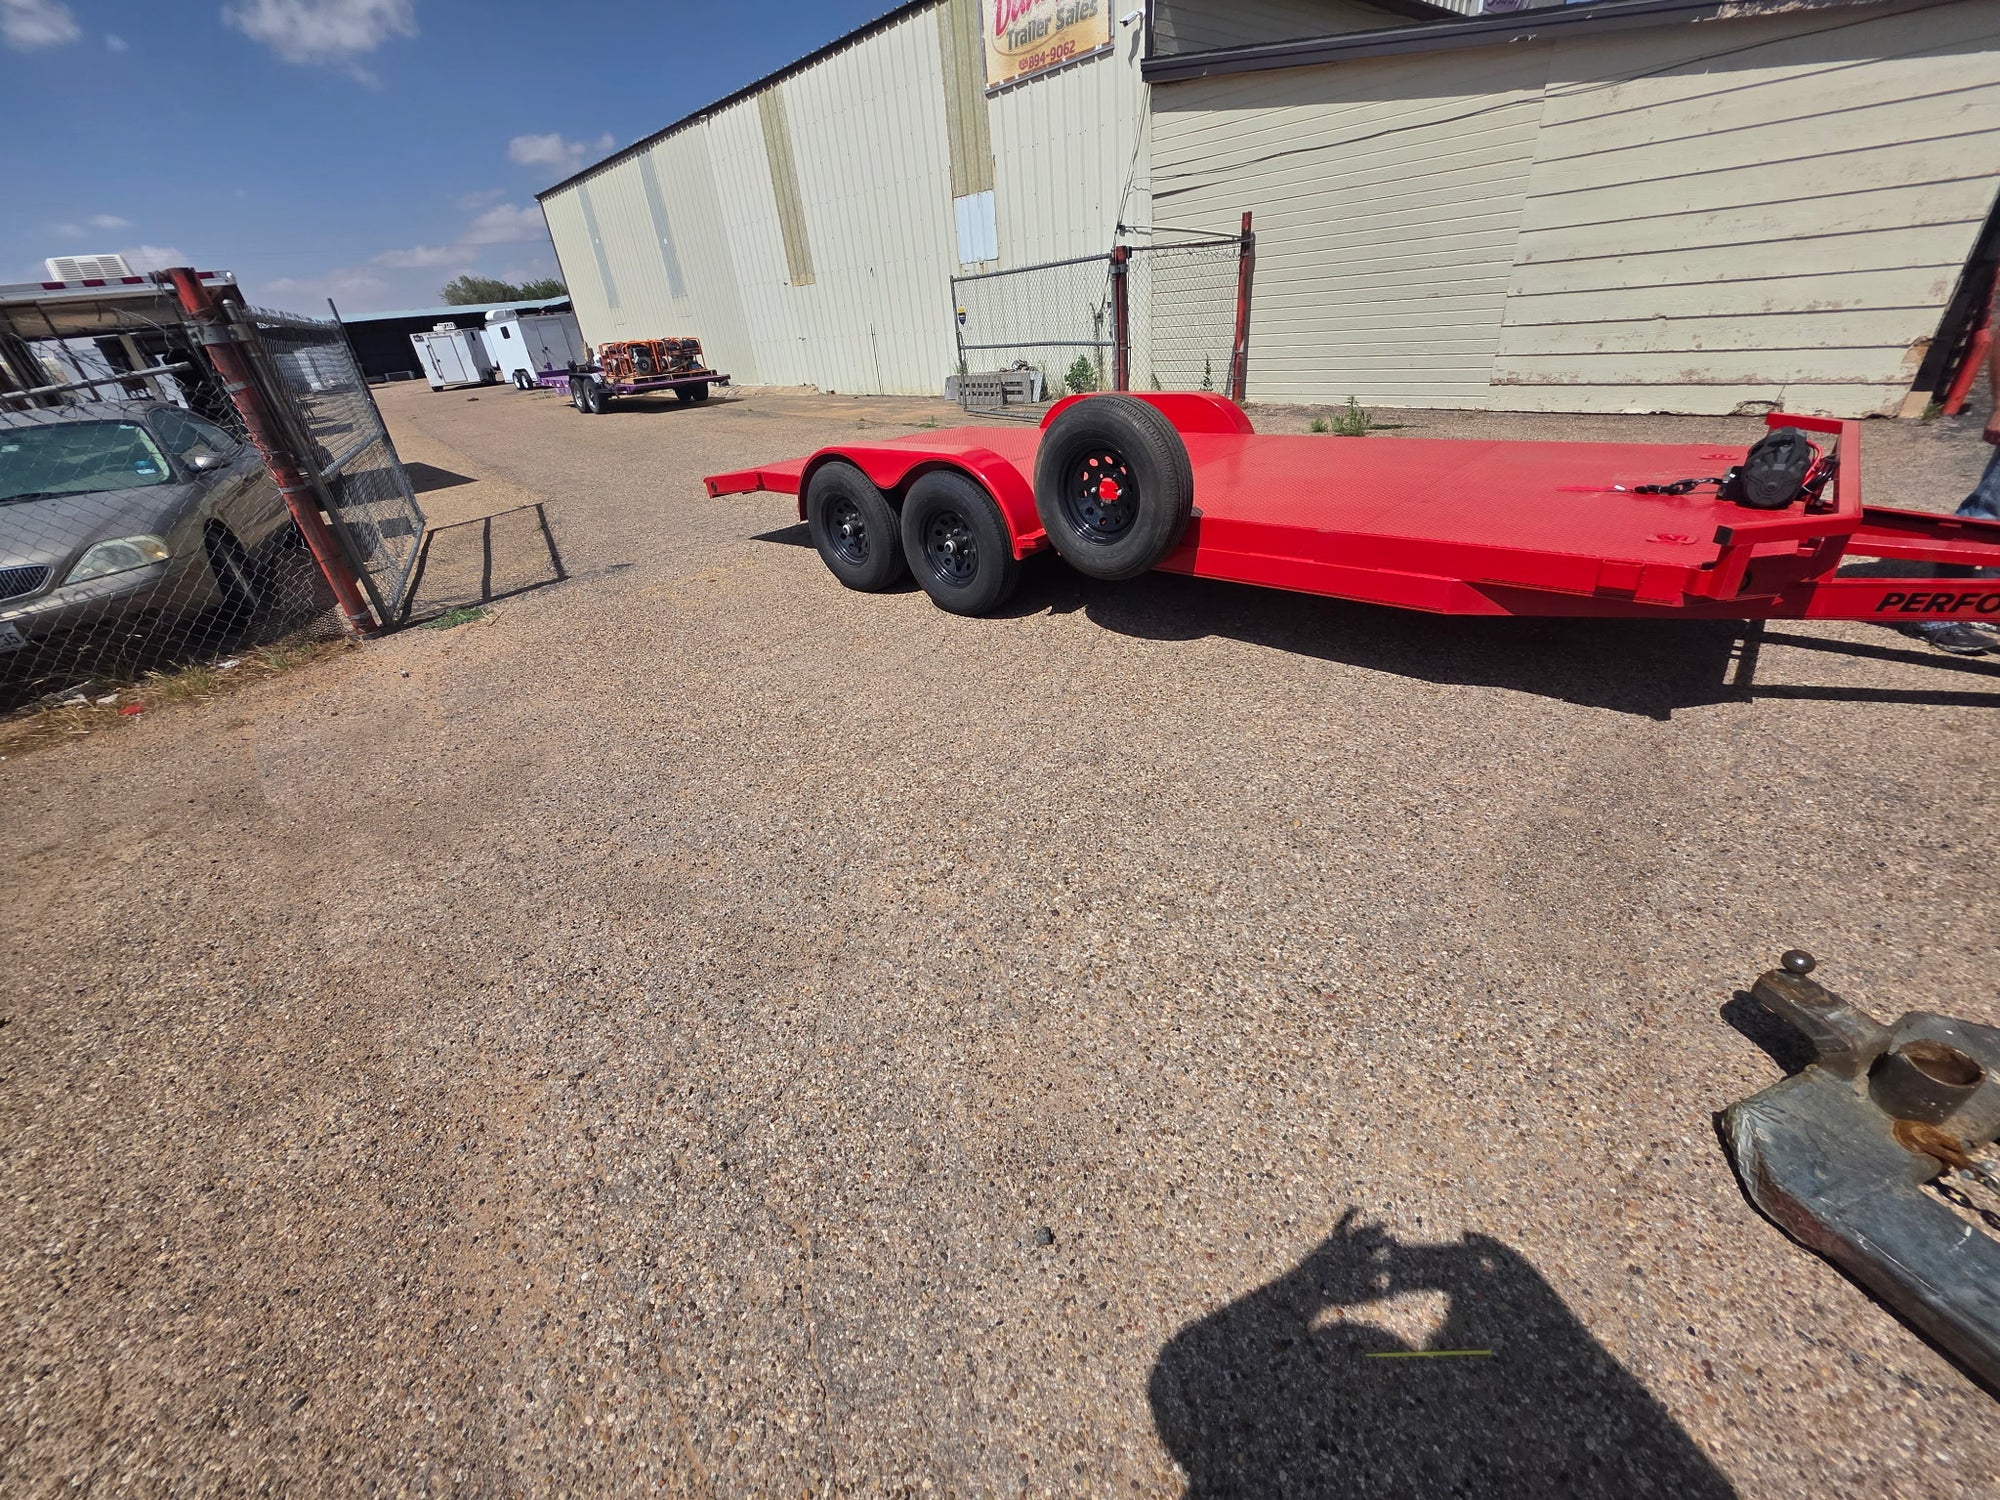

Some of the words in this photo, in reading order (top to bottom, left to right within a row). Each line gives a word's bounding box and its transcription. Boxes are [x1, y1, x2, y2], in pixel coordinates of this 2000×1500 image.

[1007, 16, 1051, 51] Trailer
[1055, 0, 1098, 30] Sales
[1029, 39, 1076, 68] 894-9062
[1874, 592, 2000, 613] PERFO
